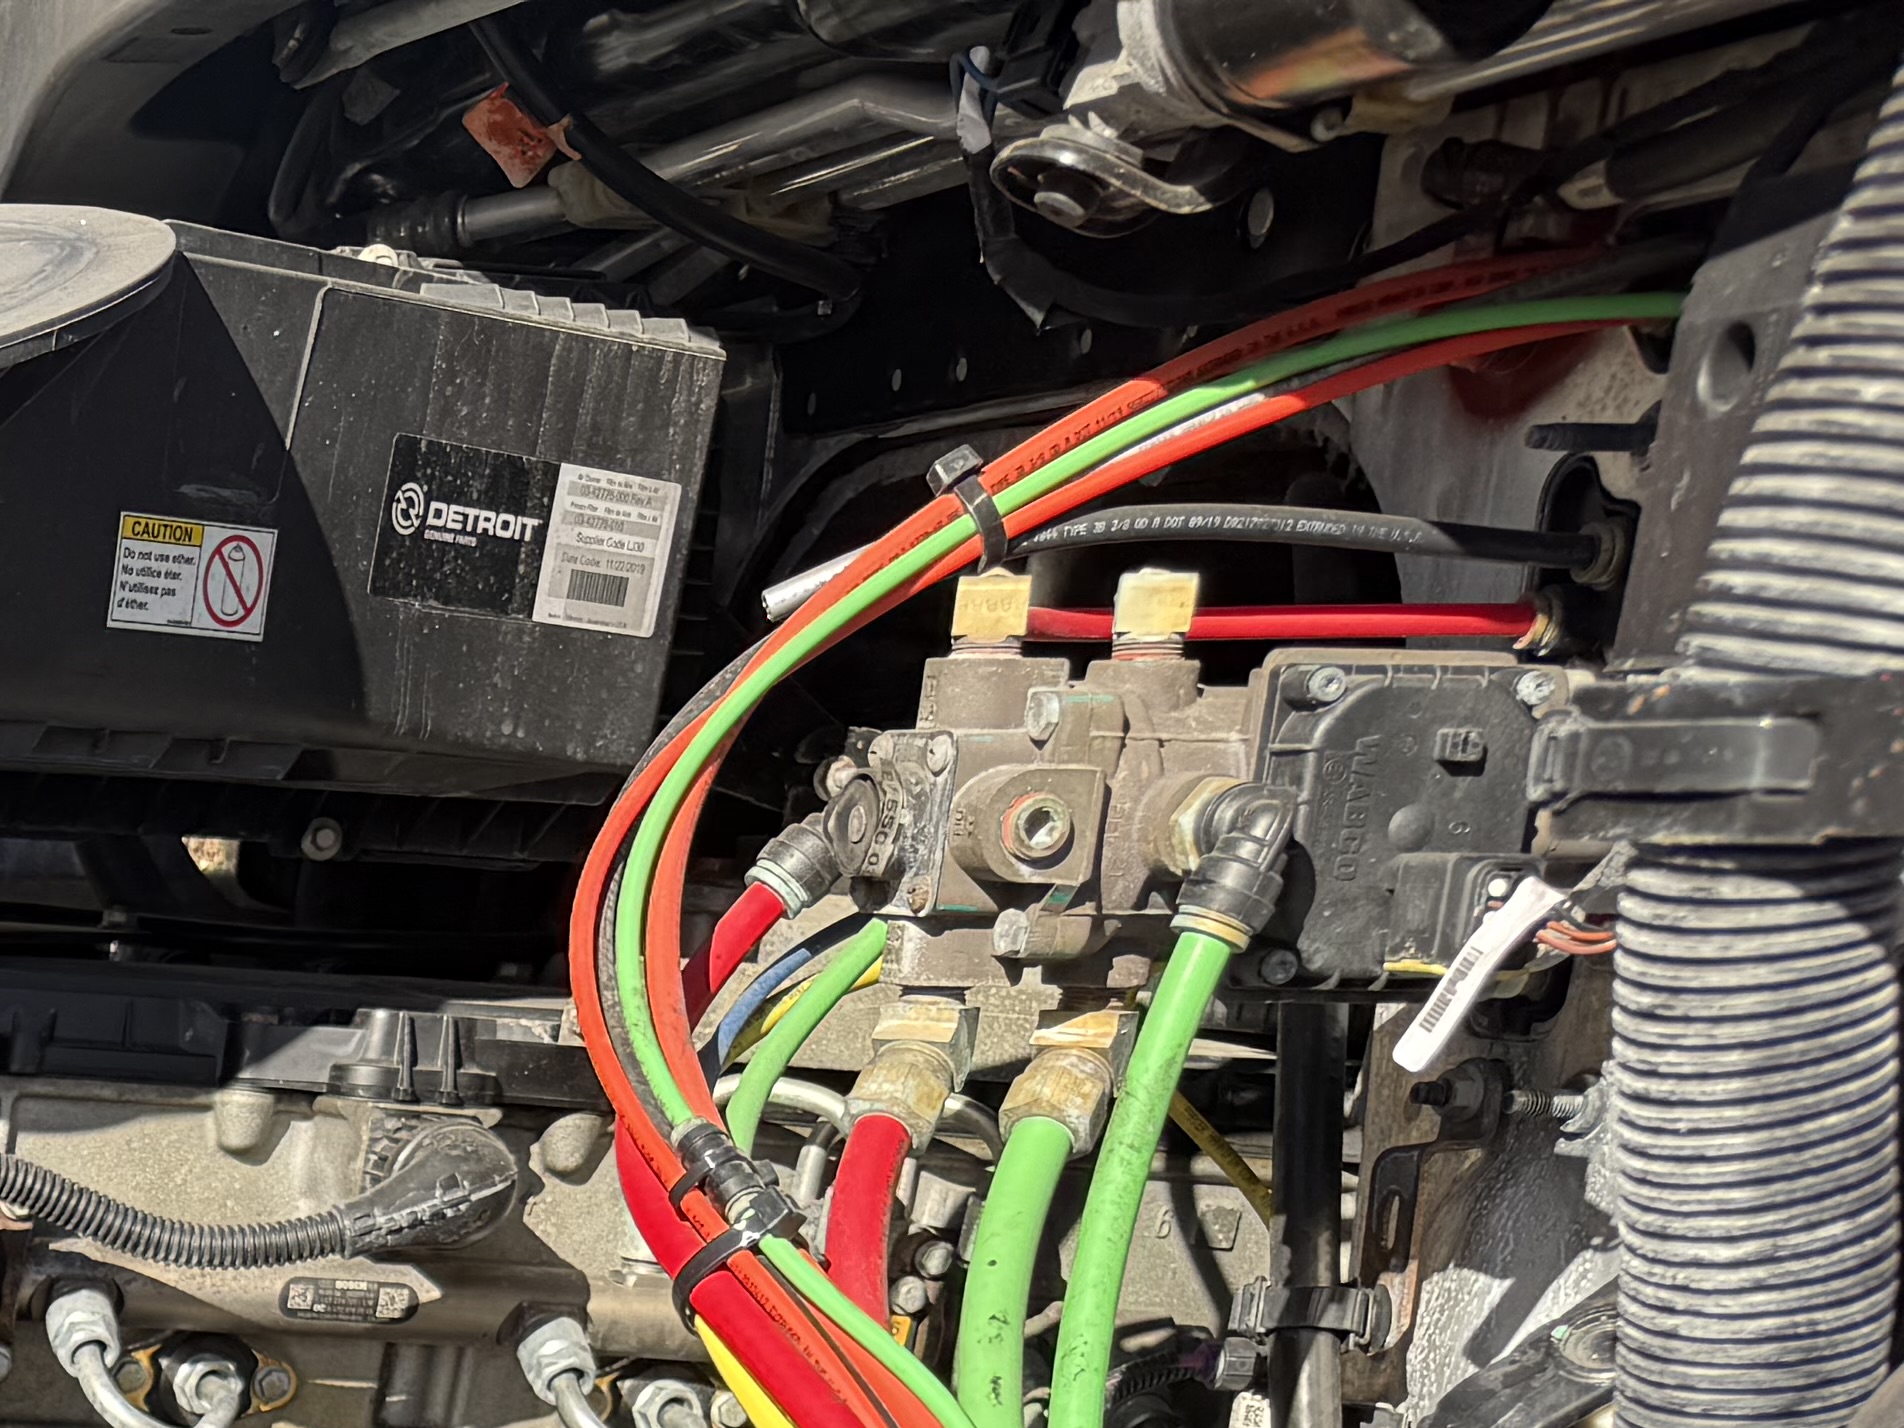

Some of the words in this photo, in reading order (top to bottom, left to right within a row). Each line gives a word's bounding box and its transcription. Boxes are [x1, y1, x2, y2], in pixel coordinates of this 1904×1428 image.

[426, 501, 539, 541] DETROIT
[1163, 516, 1184, 529] DOT
[131, 521, 193, 542] CAUTION
[606, 537, 625, 550] Code
[123, 547, 135, 558] Do
[137, 550, 152, 560] not
[154, 552, 170, 562] use
[172, 553, 196, 565] ether.
[121, 565, 133, 575] No
[135, 567, 161, 578] utilice
[163, 569, 182, 580] éter.
[119, 581, 158, 595] N'utilisez
[160, 587, 176, 598] pas
[117, 597, 149, 610] d'éther.
[1334, 735, 1381, 881] WABCO
